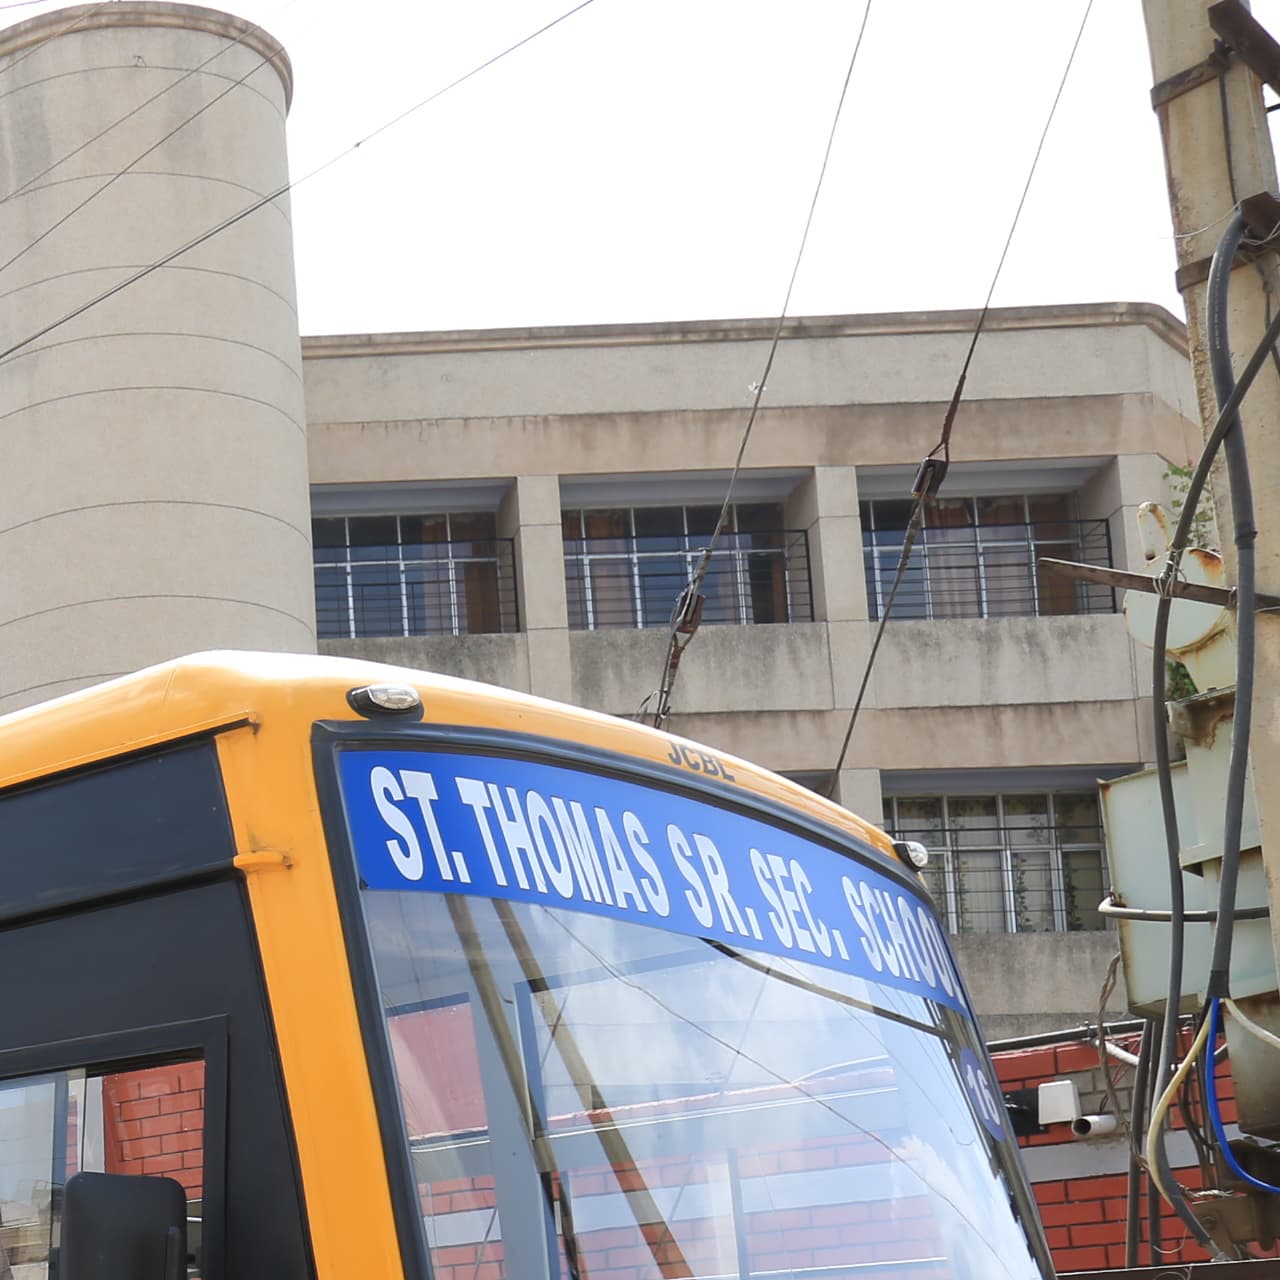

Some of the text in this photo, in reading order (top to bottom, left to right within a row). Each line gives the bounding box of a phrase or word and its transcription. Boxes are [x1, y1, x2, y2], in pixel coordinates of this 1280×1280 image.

[668, 741, 736, 783] JCBL
[370, 766, 472, 884] ST.
[454, 776, 670, 917] THOMAS
[667, 823, 763, 941] SR.
[750, 848, 850, 961] SEC.
[966, 1064, 1001, 1126] 16
